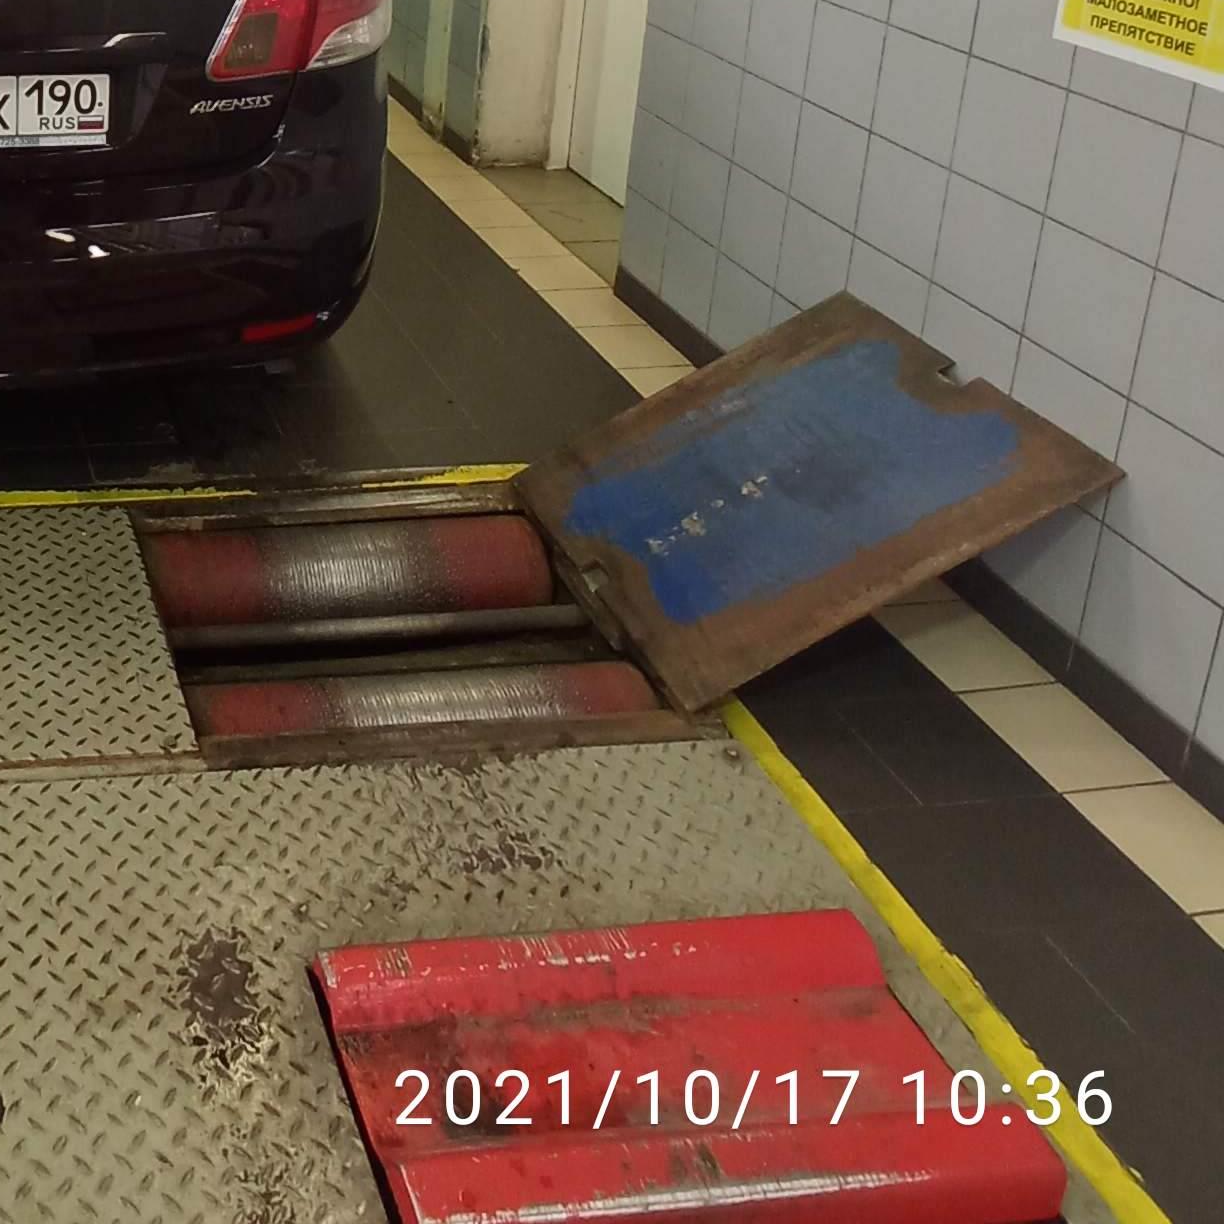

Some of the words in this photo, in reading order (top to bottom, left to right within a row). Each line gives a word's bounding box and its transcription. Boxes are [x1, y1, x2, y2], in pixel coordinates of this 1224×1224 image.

[1090, 14, 1196, 56] ПРЕПЯТСТВИЕ
[24, 79, 97, 115] 190
[189, 94, 273, 114] AVENSIS
[38, 116, 76, 130] RUS
